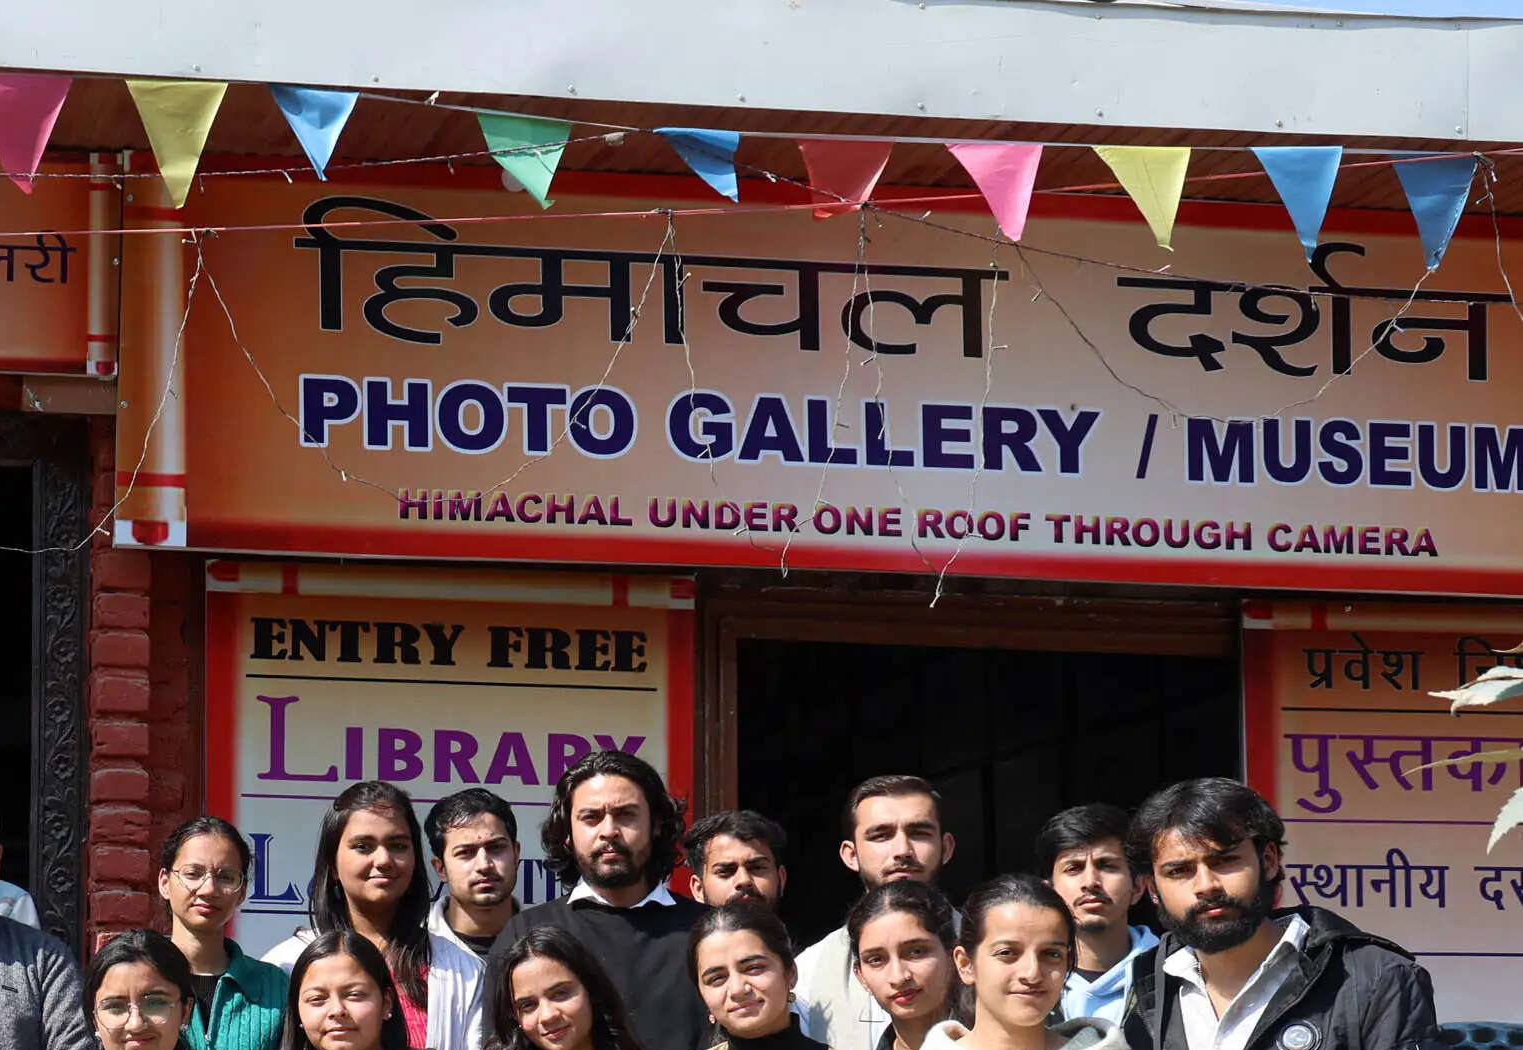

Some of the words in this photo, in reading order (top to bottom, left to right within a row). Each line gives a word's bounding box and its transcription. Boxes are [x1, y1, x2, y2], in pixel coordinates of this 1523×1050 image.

[293, 195, 1010, 359] हिमाचल
[1117, 241, 1518, 381] दर्शन
[299, 374, 638, 459] PHOTO
[667, 389, 1101, 475] GALLERY
[1135, 413, 1158, 480] /
[1186, 415, 1523, 492] MUSEUM
[398, 487, 632, 527] HIMACHAL
[647, 496, 801, 533] UNDER
[813, 504, 903, 538] ONE
[917, 506, 1031, 542] ROOF
[1045, 513, 1252, 551] THROUGH
[1267, 522, 1439, 557] CAMERA
[250, 616, 464, 665] ENTRY
[487, 626, 648, 673] FREE
[1303, 632, 1424, 691] प्रवेश
[1286, 847, 1449, 909] स्थानीय
